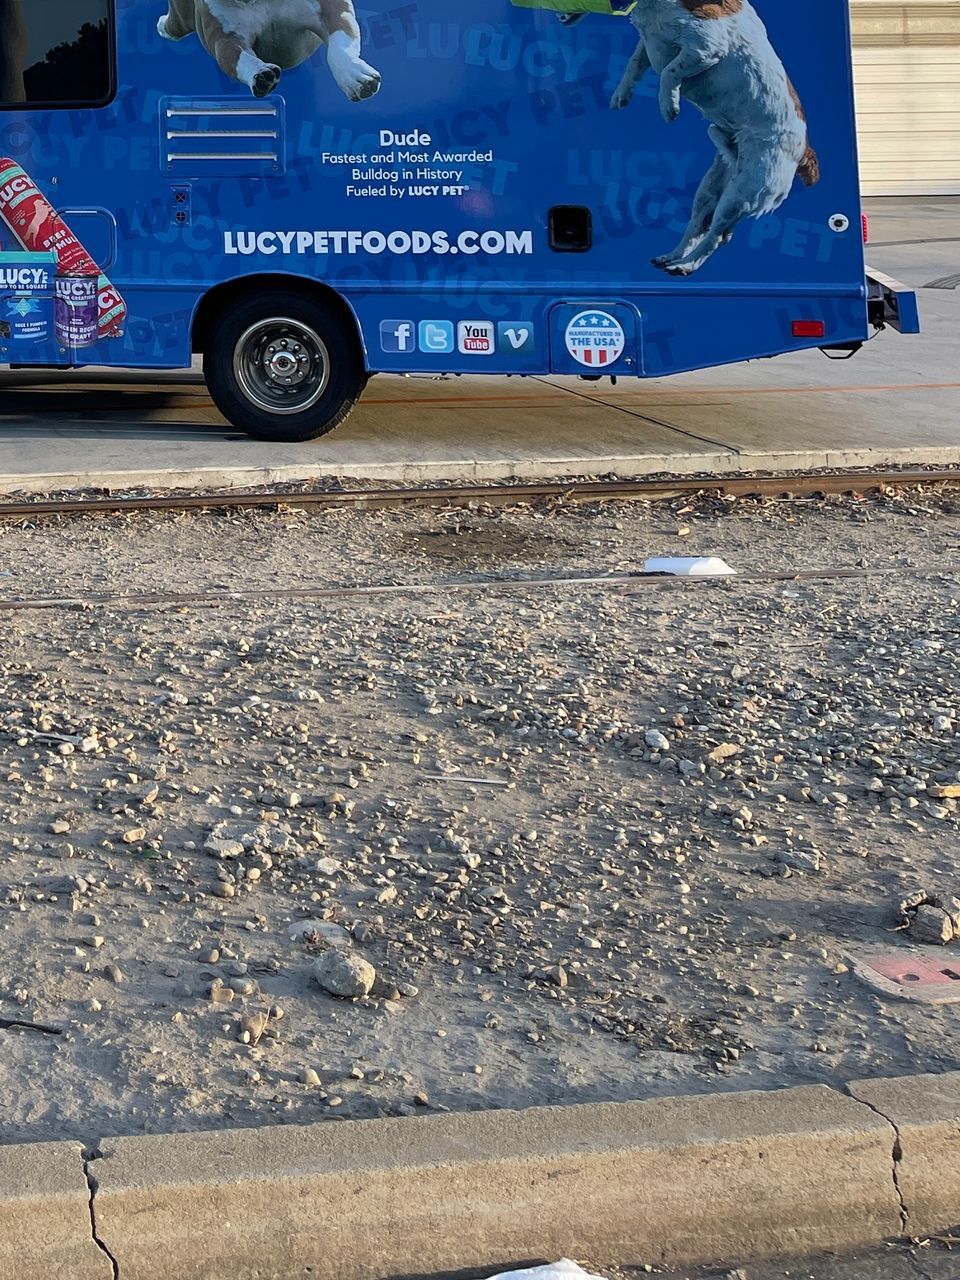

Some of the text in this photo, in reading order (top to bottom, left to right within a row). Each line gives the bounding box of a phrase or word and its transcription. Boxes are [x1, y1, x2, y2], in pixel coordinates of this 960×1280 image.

[380, 129, 431, 146] Dude
[322, 150, 492, 164] Fastest and Most Awarded
[353, 168, 462, 181] Bulldog in History
[347, 185, 386, 196] Fueled
[390, 185, 405, 198] by
[409, 186, 439, 195] LUCY
[224, 231, 532, 254] LUCYPETFOODS.COM
[0, 269, 43, 284] LUCY
[56, 281, 92, 295] LUCY
[465, 325, 488, 338] You
[466, 340, 488, 349] Tube
[571, 338, 590, 346] THE
